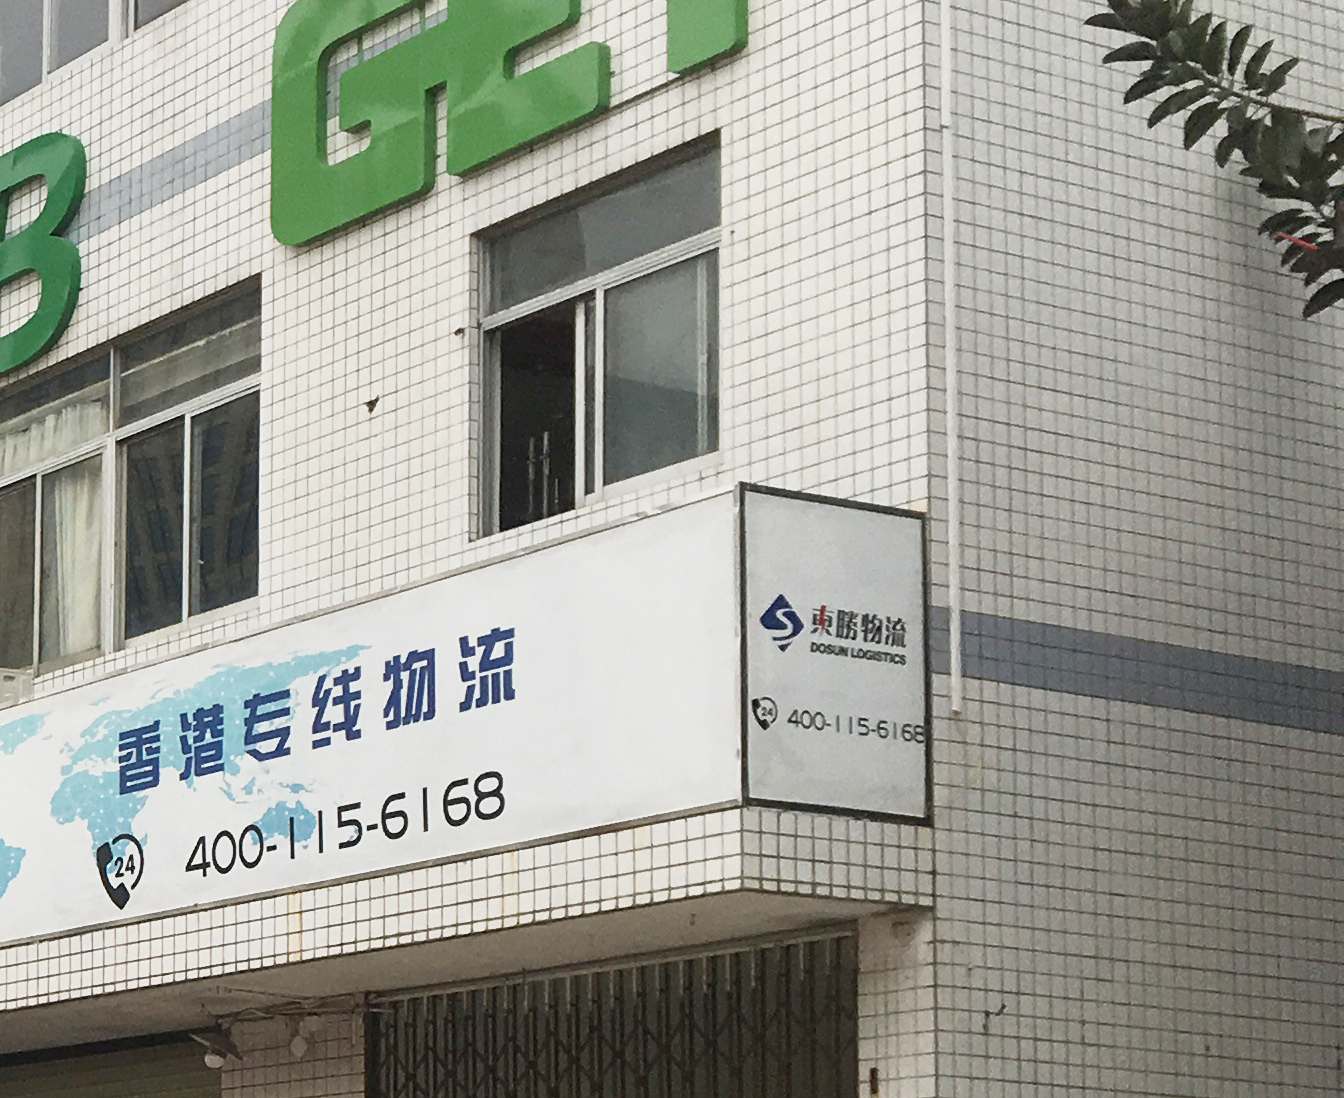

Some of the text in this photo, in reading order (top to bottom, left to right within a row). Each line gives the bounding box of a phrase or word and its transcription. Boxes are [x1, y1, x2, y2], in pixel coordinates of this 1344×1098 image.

[271, 0, 749, 247] GE
[810, 641, 907, 666] DOSUN LOGISTICS
[118, 627, 516, 795] 香港专线物流
[761, 706, 774, 717] 24
[787, 709, 925, 743] 400-115-6168
[185, 770, 506, 878] 400-115-6168
[114, 853, 136, 878] 24
